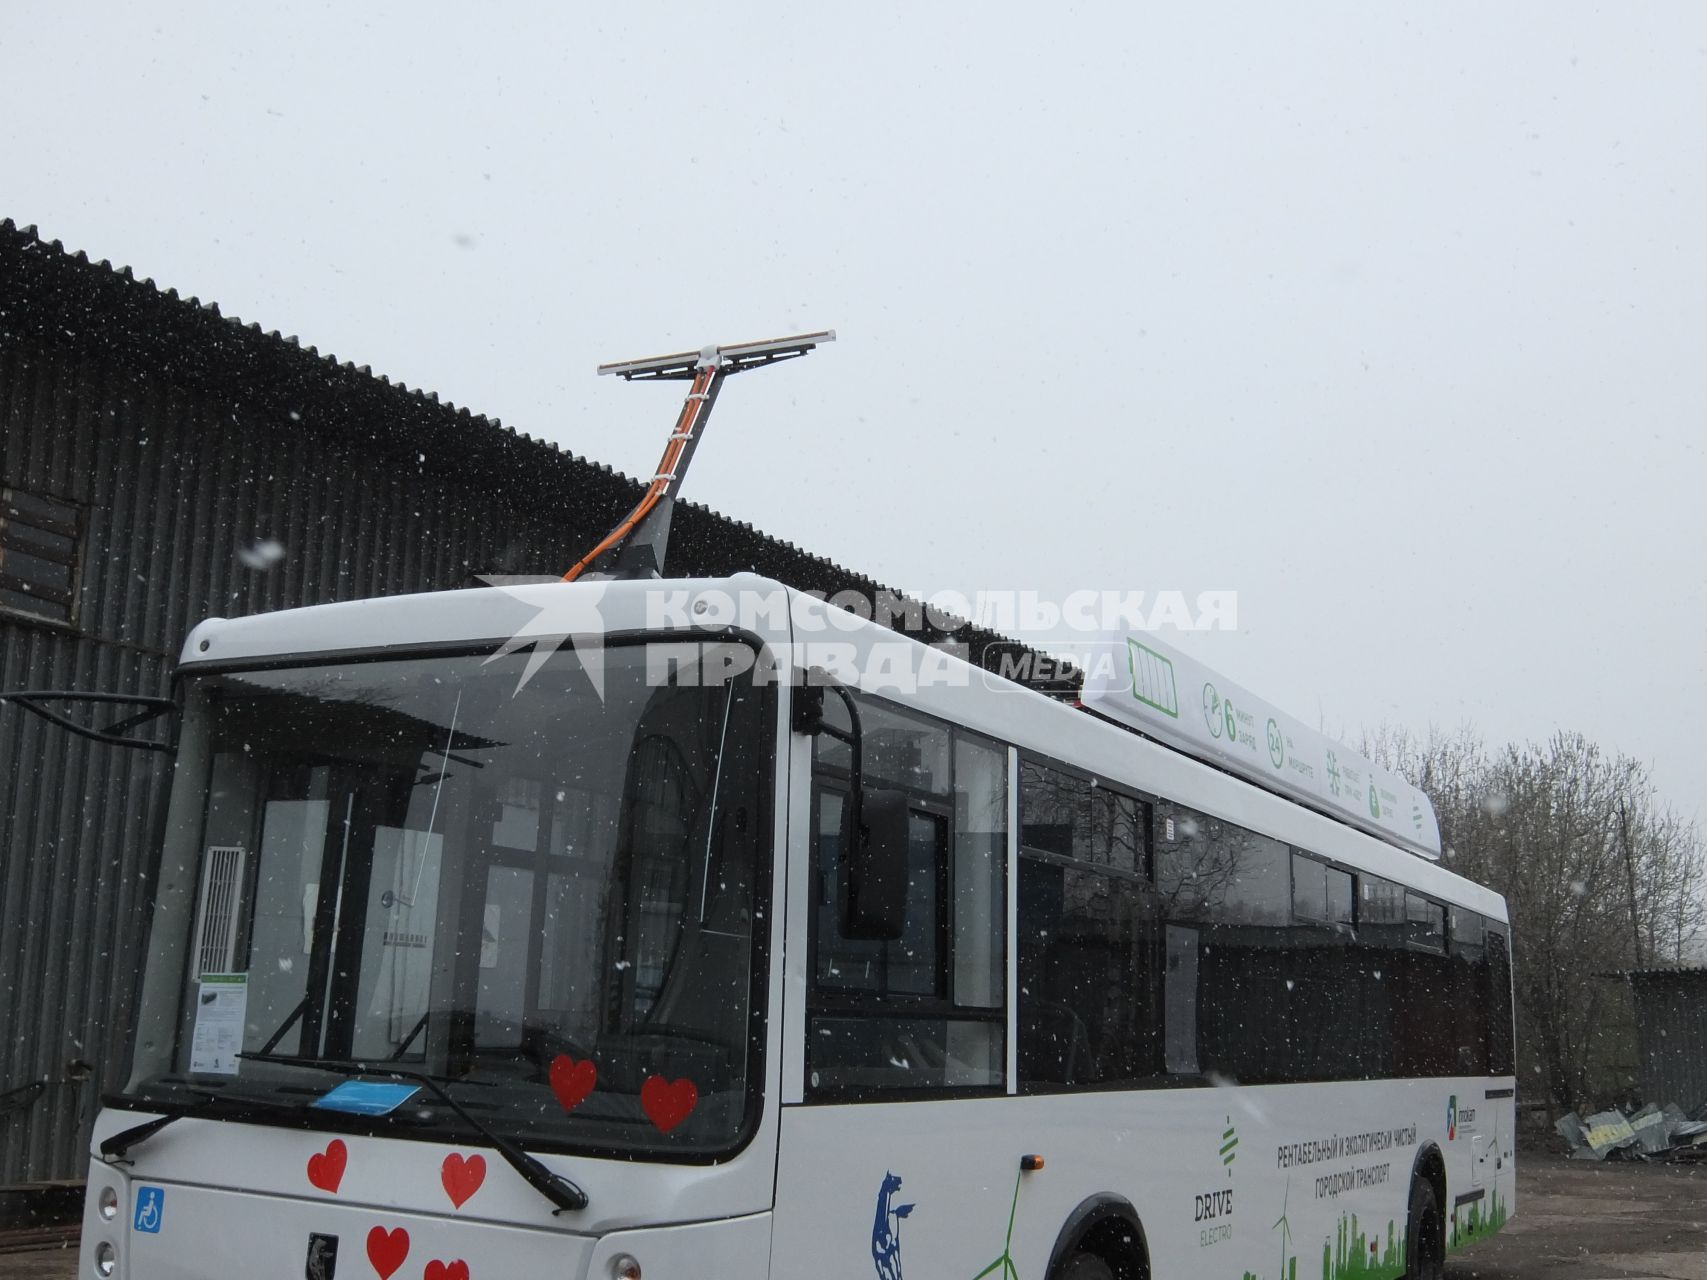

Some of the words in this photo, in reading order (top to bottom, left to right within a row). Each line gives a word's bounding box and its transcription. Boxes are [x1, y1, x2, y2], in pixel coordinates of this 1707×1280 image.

[1224, 699, 1235, 742] 6
[1270, 733, 1280, 753] 24
[1277, 1133, 1338, 1169] РЕНТАБЕЛЬНЫЙ
[1338, 1138, 1344, 1158] И
[1345, 1131, 1392, 1157] ЭКОЛОГИЧЕСКИ
[1394, 1123, 1417, 1147] ЧИСТЫЙ
[1315, 1165, 1355, 1199] ГОРОДСКОЙ
[1356, 1163, 1390, 1188] ТРАНСПОРТ
[1195, 1189, 1233, 1222] DRIVE
[1200, 1224, 1232, 1247] ELECTRO
